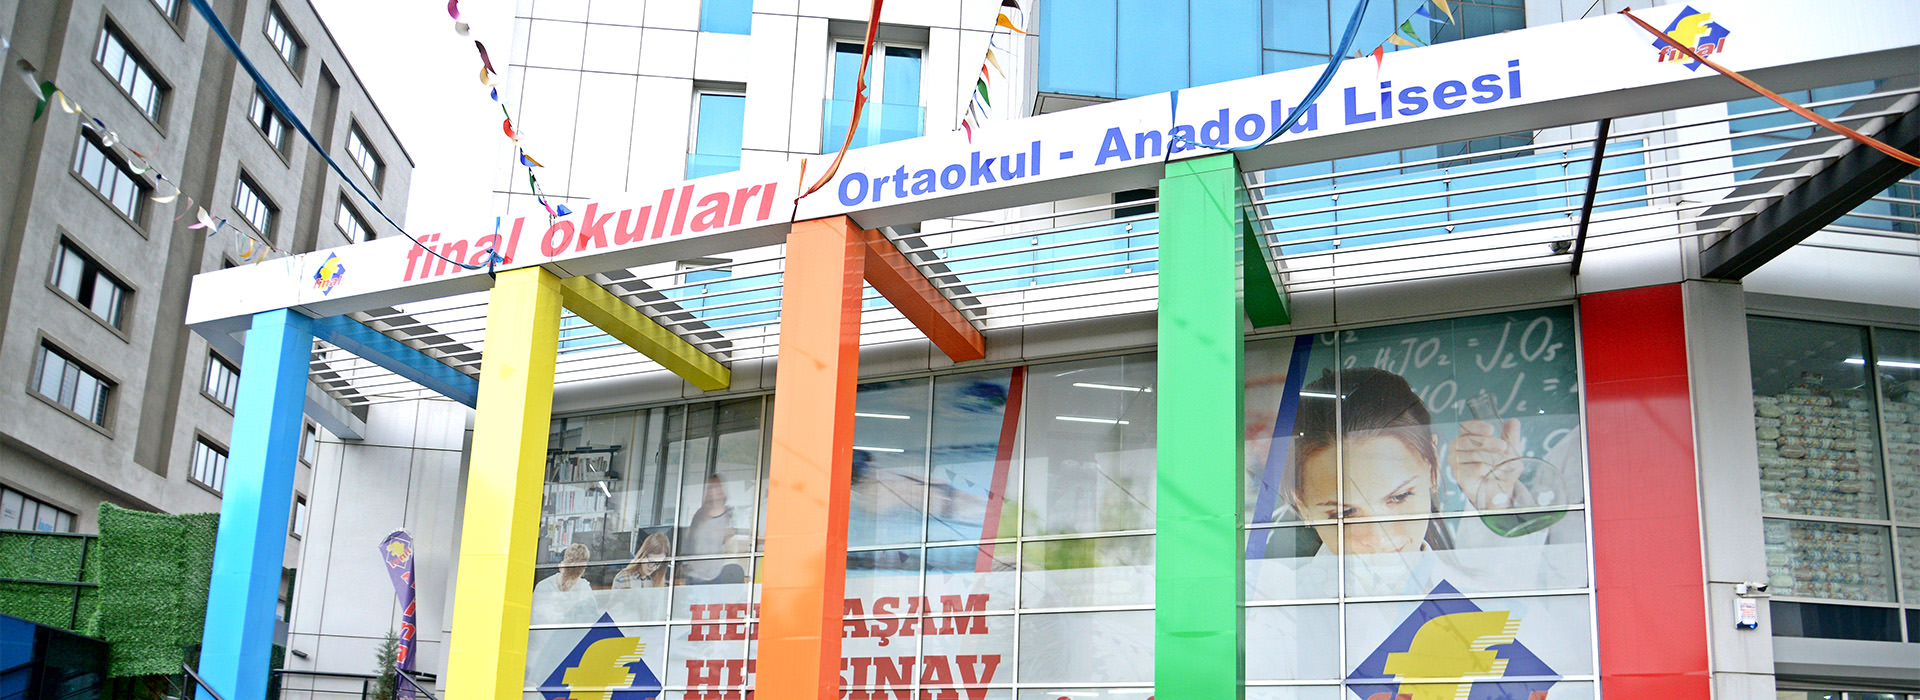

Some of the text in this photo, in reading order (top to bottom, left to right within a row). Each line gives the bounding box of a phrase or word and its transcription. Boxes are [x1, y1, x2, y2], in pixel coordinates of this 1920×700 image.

[1658, 37, 1726, 63] final
[838, 59, 1522, 207] Ortaokul - Anadolu Lisesi
[403, 182, 778, 282] final okulları
[686, 593, 990, 648] HE AŞAM
[683, 654, 1001, 700] HE INAV
